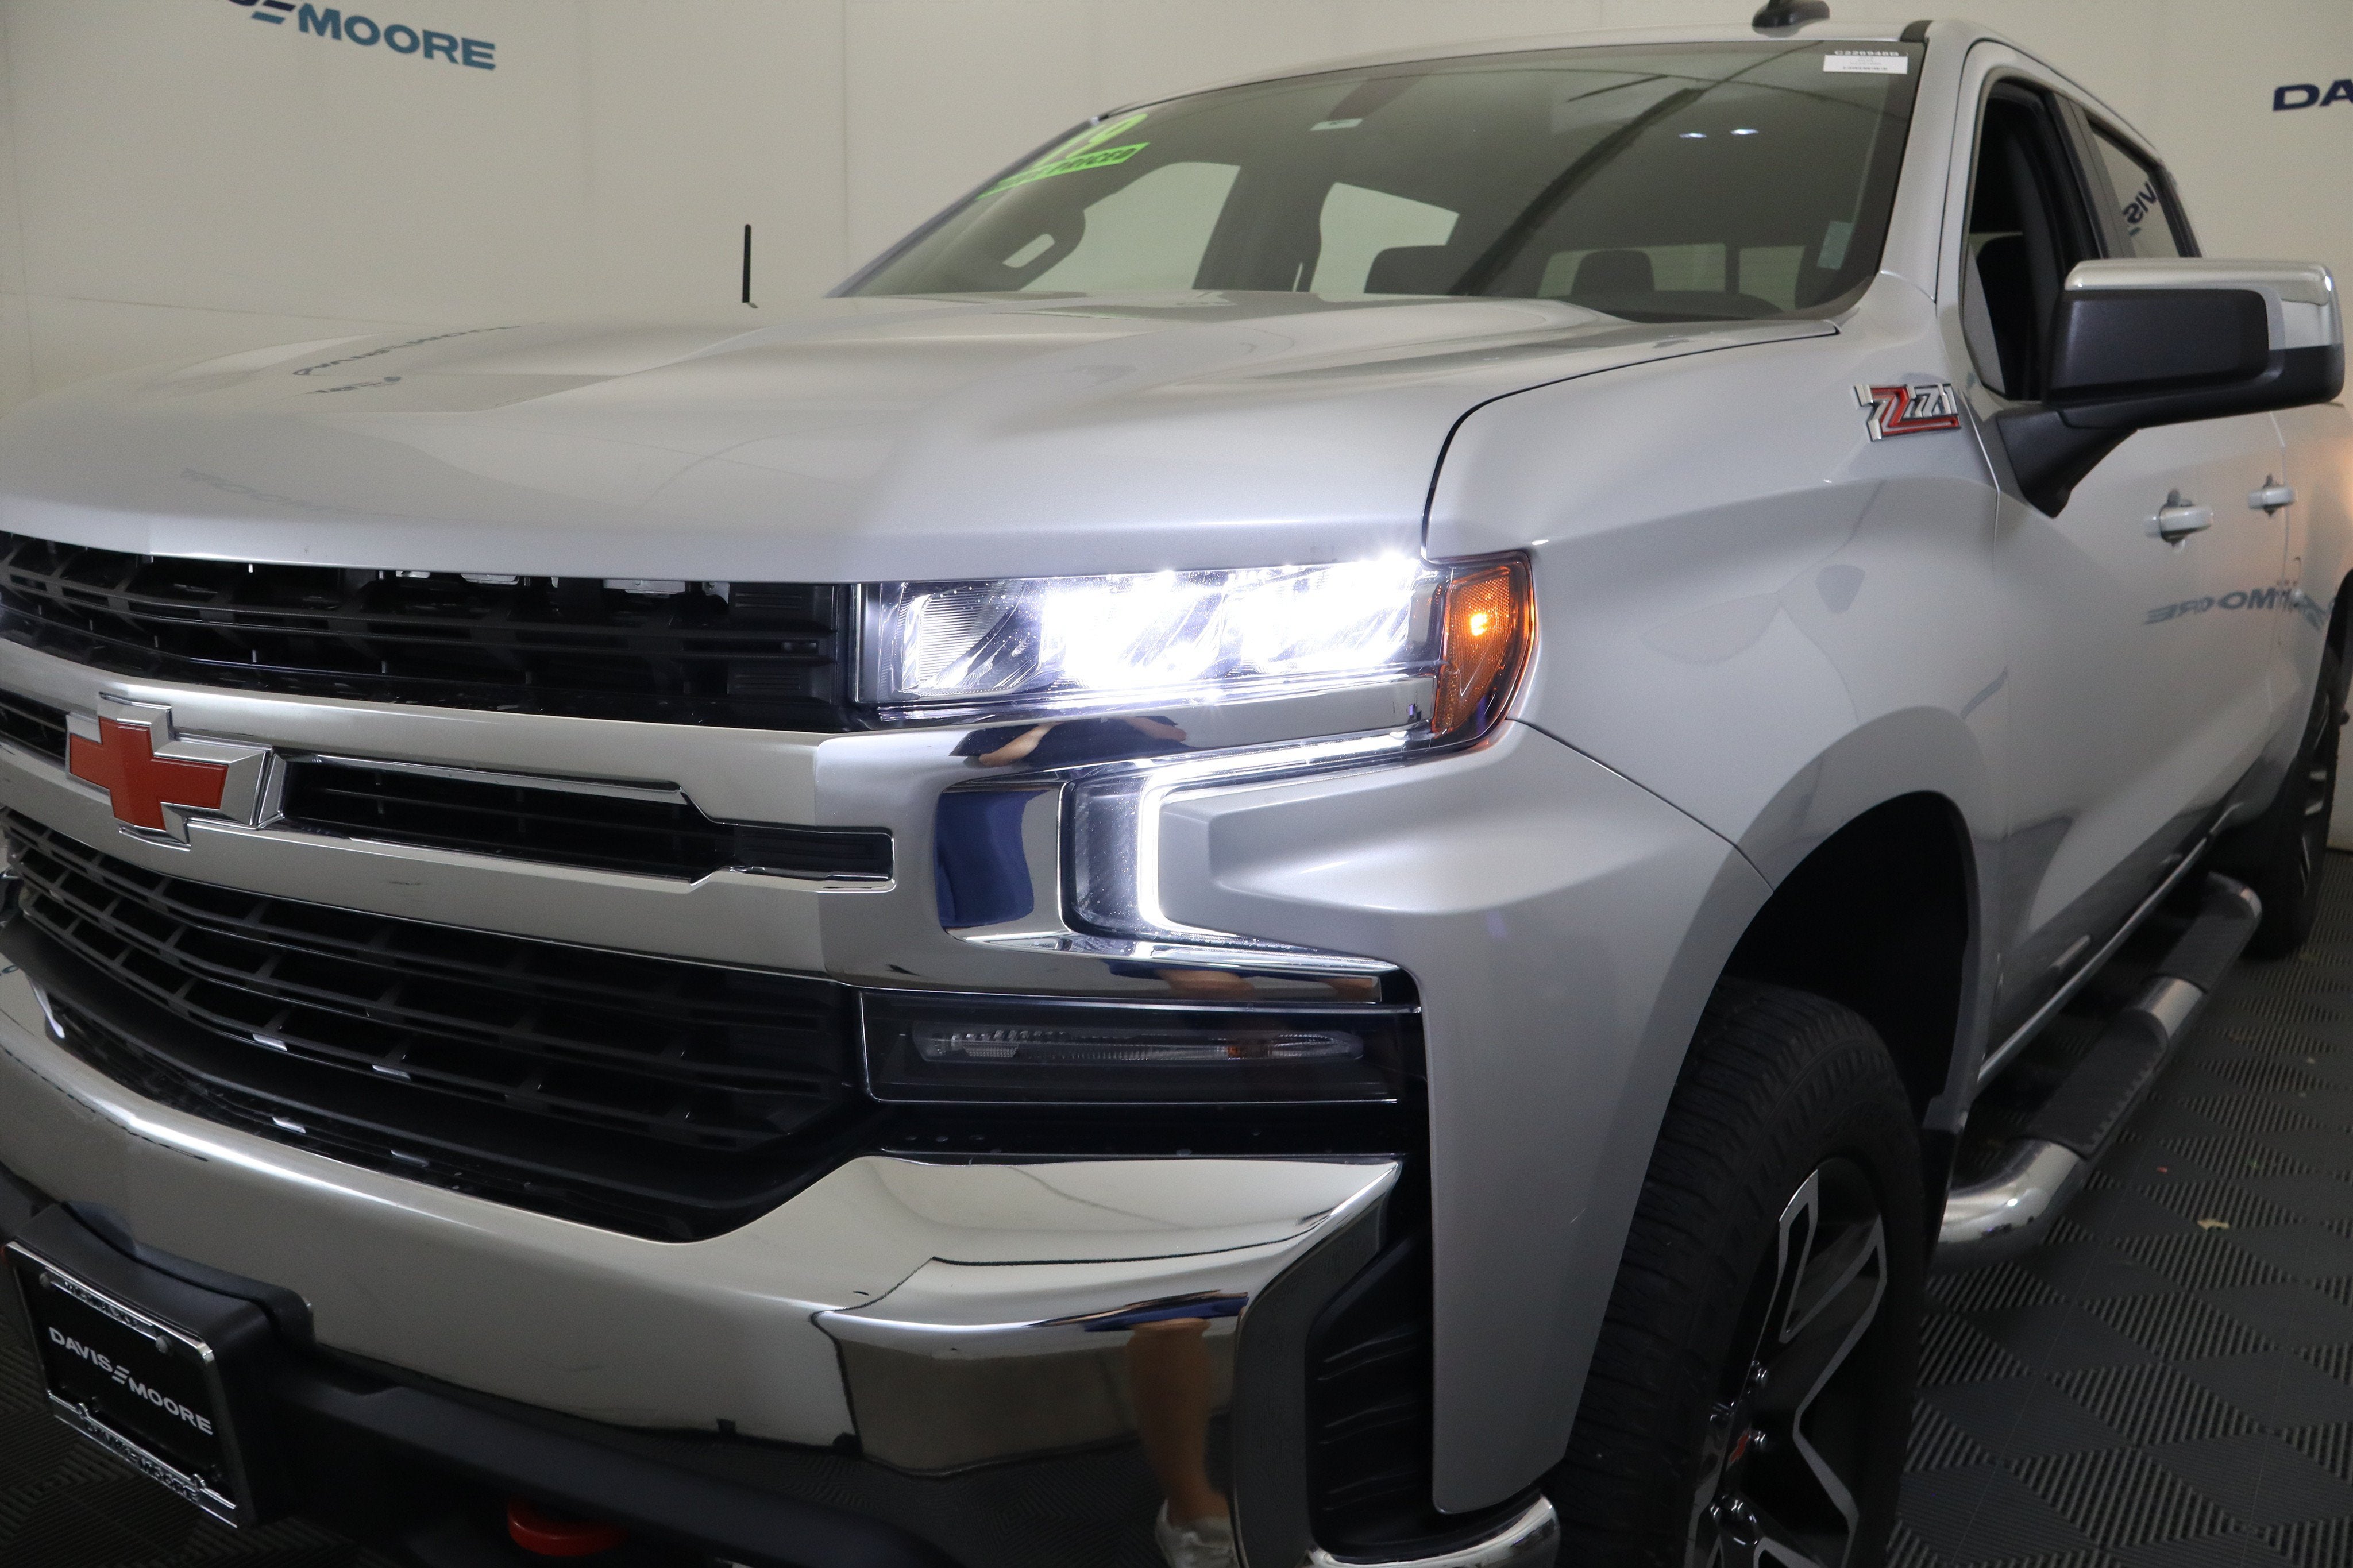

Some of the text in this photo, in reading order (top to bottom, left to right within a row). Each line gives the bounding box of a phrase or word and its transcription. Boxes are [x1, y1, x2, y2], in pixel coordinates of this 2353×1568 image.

[297, 2, 496, 71] MOORE
[1853, 383, 1962, 442] Z71
[48, 1326, 213, 1435] DAVIS MOORE
